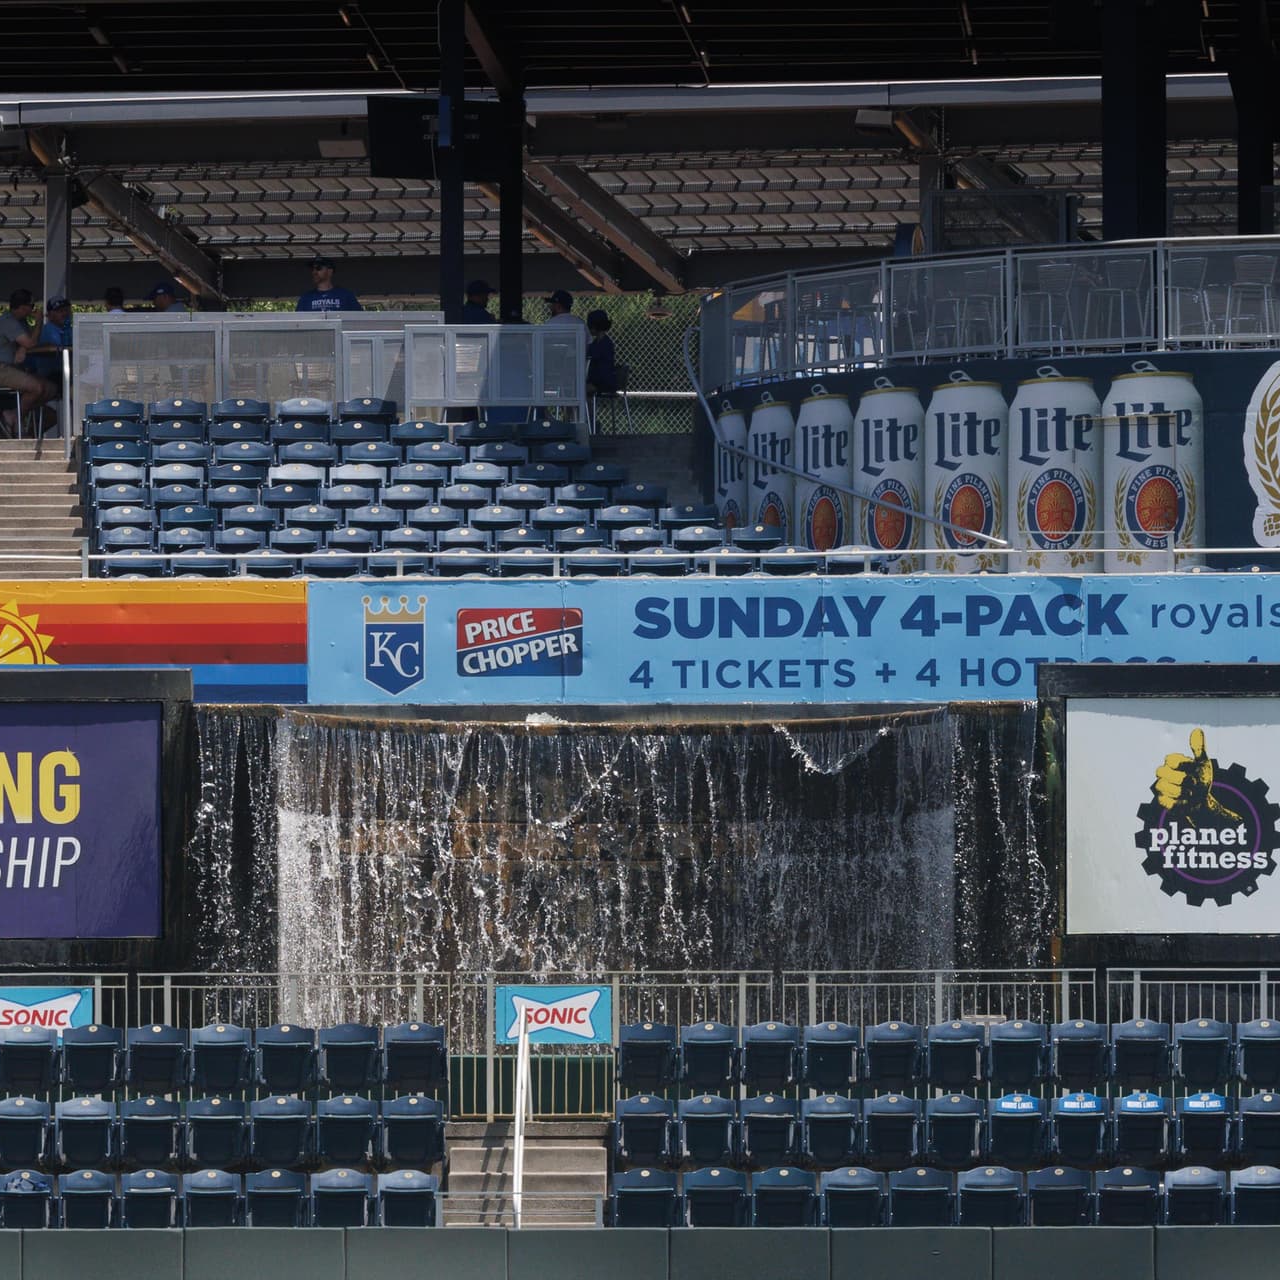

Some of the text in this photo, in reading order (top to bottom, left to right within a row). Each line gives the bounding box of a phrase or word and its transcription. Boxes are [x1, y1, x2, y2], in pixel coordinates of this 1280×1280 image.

[802, 424, 848, 478] Lite
[861, 418, 918, 476] Lite
[934, 412, 1001, 471] Lite
[1019, 407, 1093, 466] Lite
[1113, 402, 1193, 462] Lite
[753, 432, 791, 490] Lite
[1130, 468, 1152, 493] FINE
[1032, 471, 1052, 496] FINE
[1053, 469, 1082, 505] PILSNER
[1145, 537, 1168, 548] BEE
[464, 610, 536, 644] PRICE
[633, 595, 886, 640] SUNDAY
[900, 593, 1128, 637] 4-PACK
[369, 630, 420, 678] KC
[462, 632, 579, 675] CHOPPER
[629, 659, 654, 689] 4
[672, 659, 856, 689] TICKETS
[915, 659, 941, 687] 4
[1149, 822, 1247, 851] planet
[1162, 845, 1268, 869] fitness
[0, 1009, 68, 1026] SONIC
[519, 1007, 587, 1024] SONIC
